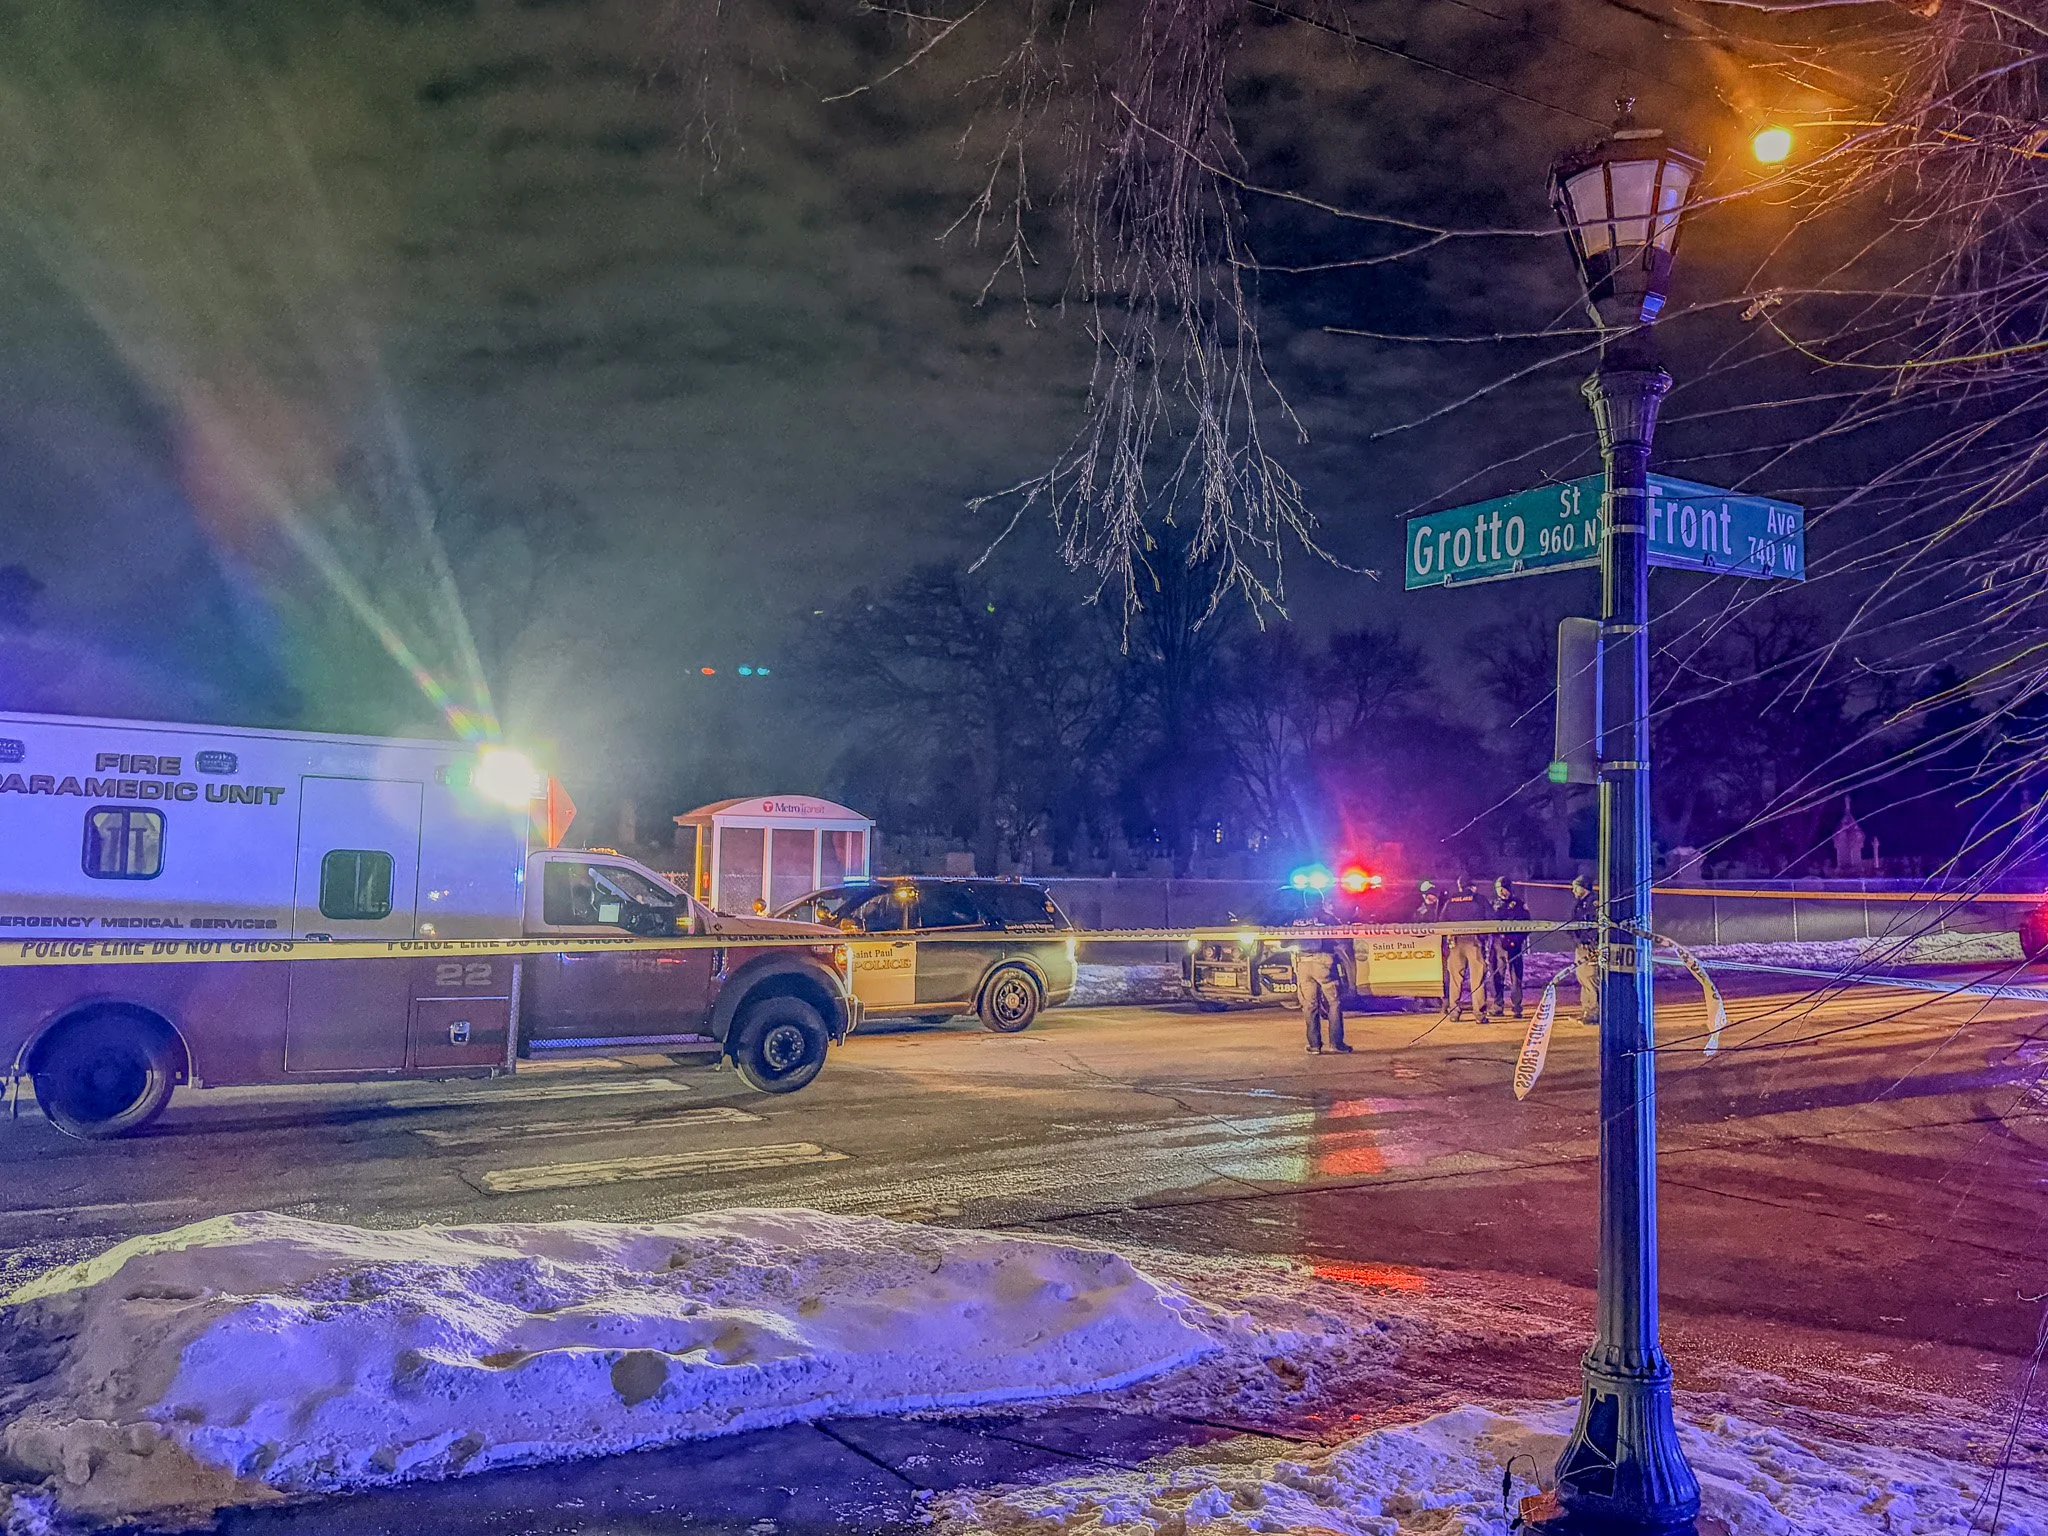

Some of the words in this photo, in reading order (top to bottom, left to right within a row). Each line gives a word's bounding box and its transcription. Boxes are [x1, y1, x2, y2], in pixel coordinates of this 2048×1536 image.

[1559, 486, 1581, 518] St
[1648, 485, 1732, 555] Front
[1767, 506, 1796, 537] Ave
[1413, 511, 1525, 575] Grotto
[1539, 523, 1575, 556] 960
[1584, 518, 1597, 548] N
[1748, 536, 1777, 567] 740
[1782, 543, 1797, 572] W
[95, 752, 182, 776] FIRE
[0, 774, 198, 801] ARAMEDIC
[205, 784, 286, 805] UNIT
[101, 917, 184, 929] MEDICAL
[190, 918, 278, 929] SERVICES
[20, 941, 96, 958] POLICE
[101, 941, 146, 956] LINE
[152, 941, 180, 955] DO
[185, 940, 224, 954] NOT
[230, 940, 294, 953] CROSS
[875, 948, 893, 958] Paul
[1373, 943, 1395, 951] Saint
[1397, 942, 1415, 950] Paul
[1373, 950, 1436, 961] POLICE
[436, 963, 492, 986] 22
[852, 958, 912, 973] POLICE
